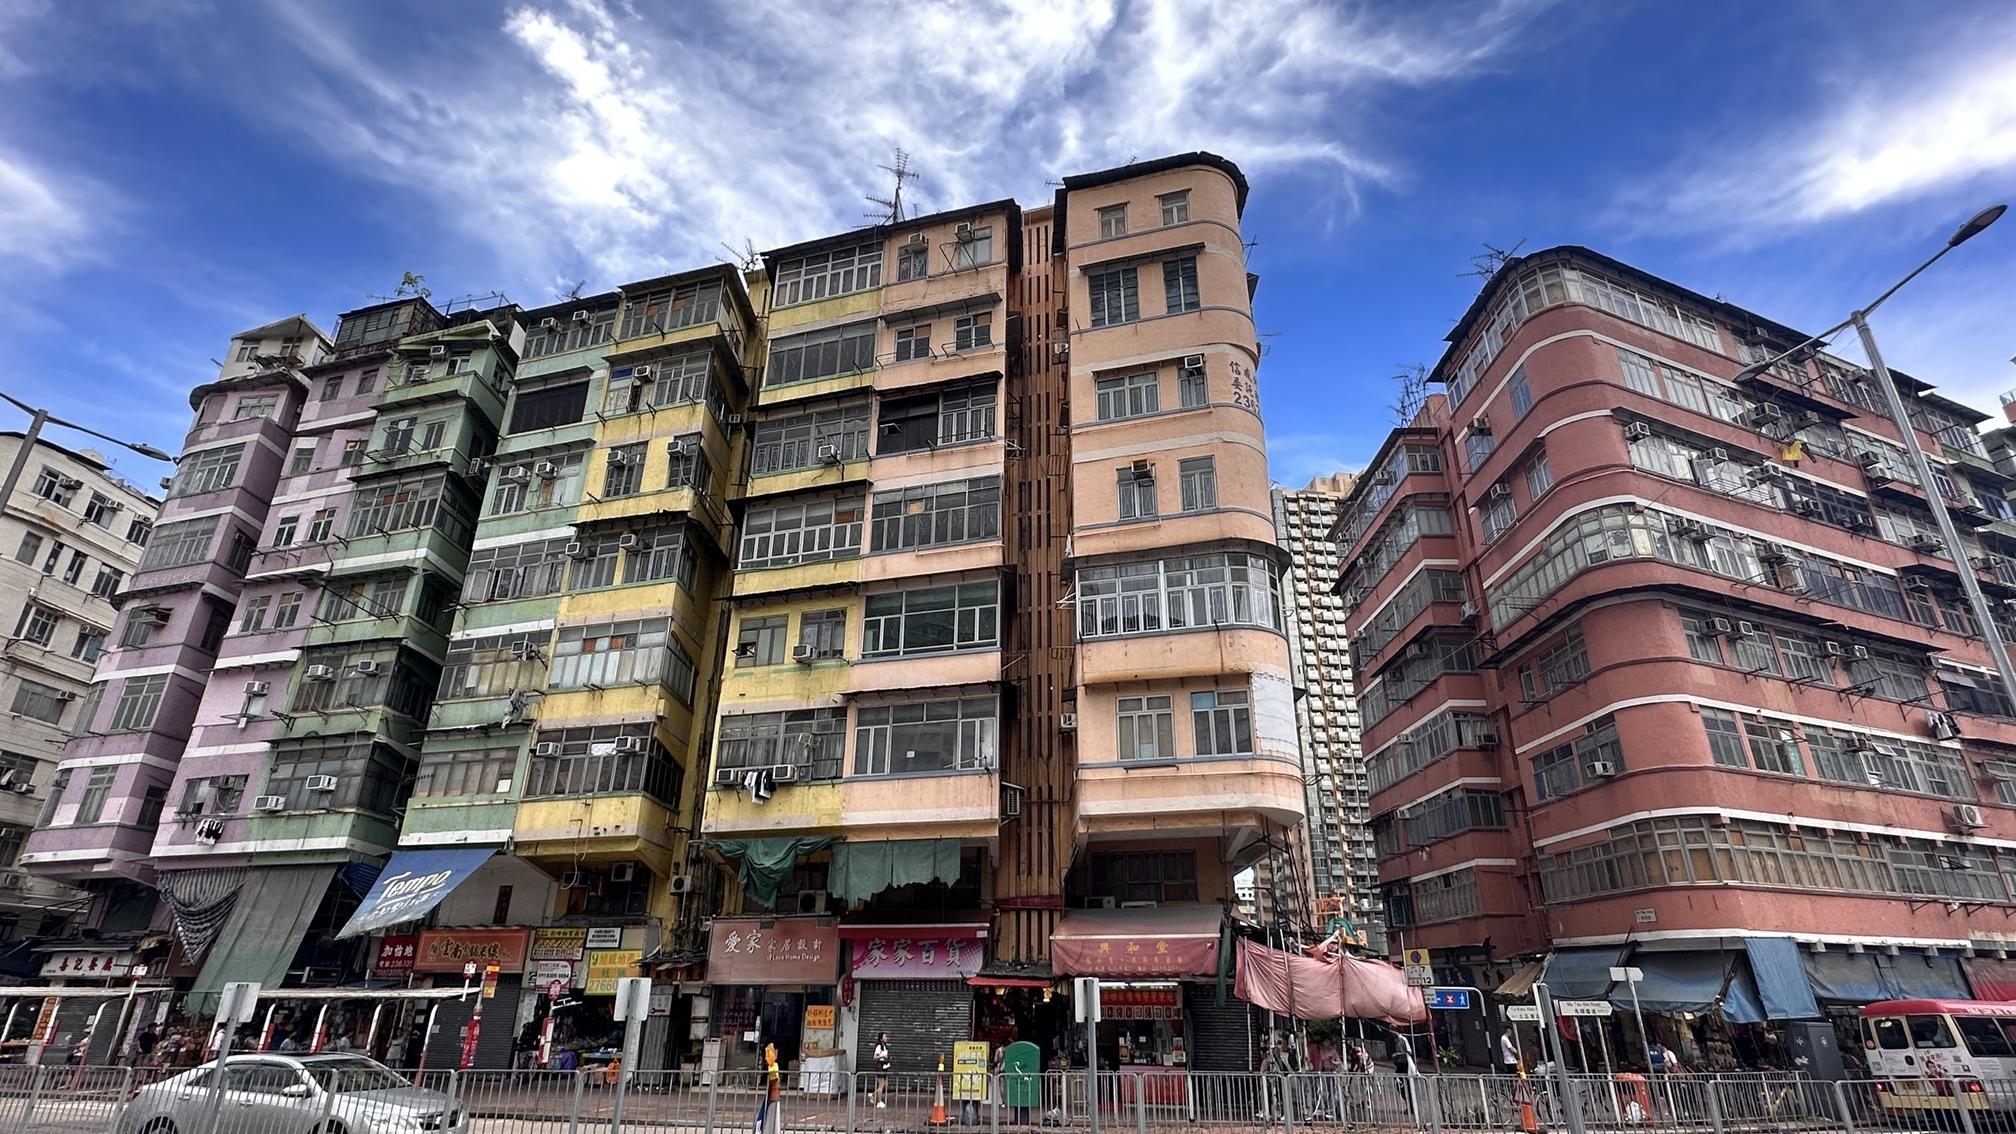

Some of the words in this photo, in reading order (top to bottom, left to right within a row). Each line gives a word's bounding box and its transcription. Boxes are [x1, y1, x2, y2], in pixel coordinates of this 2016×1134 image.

[376, 870, 452, 904] Tempo
[724, 929, 763, 954] 愛家
[867, 938, 967, 967] 家家百貨
[1423, 976, 1432, 984] 12
